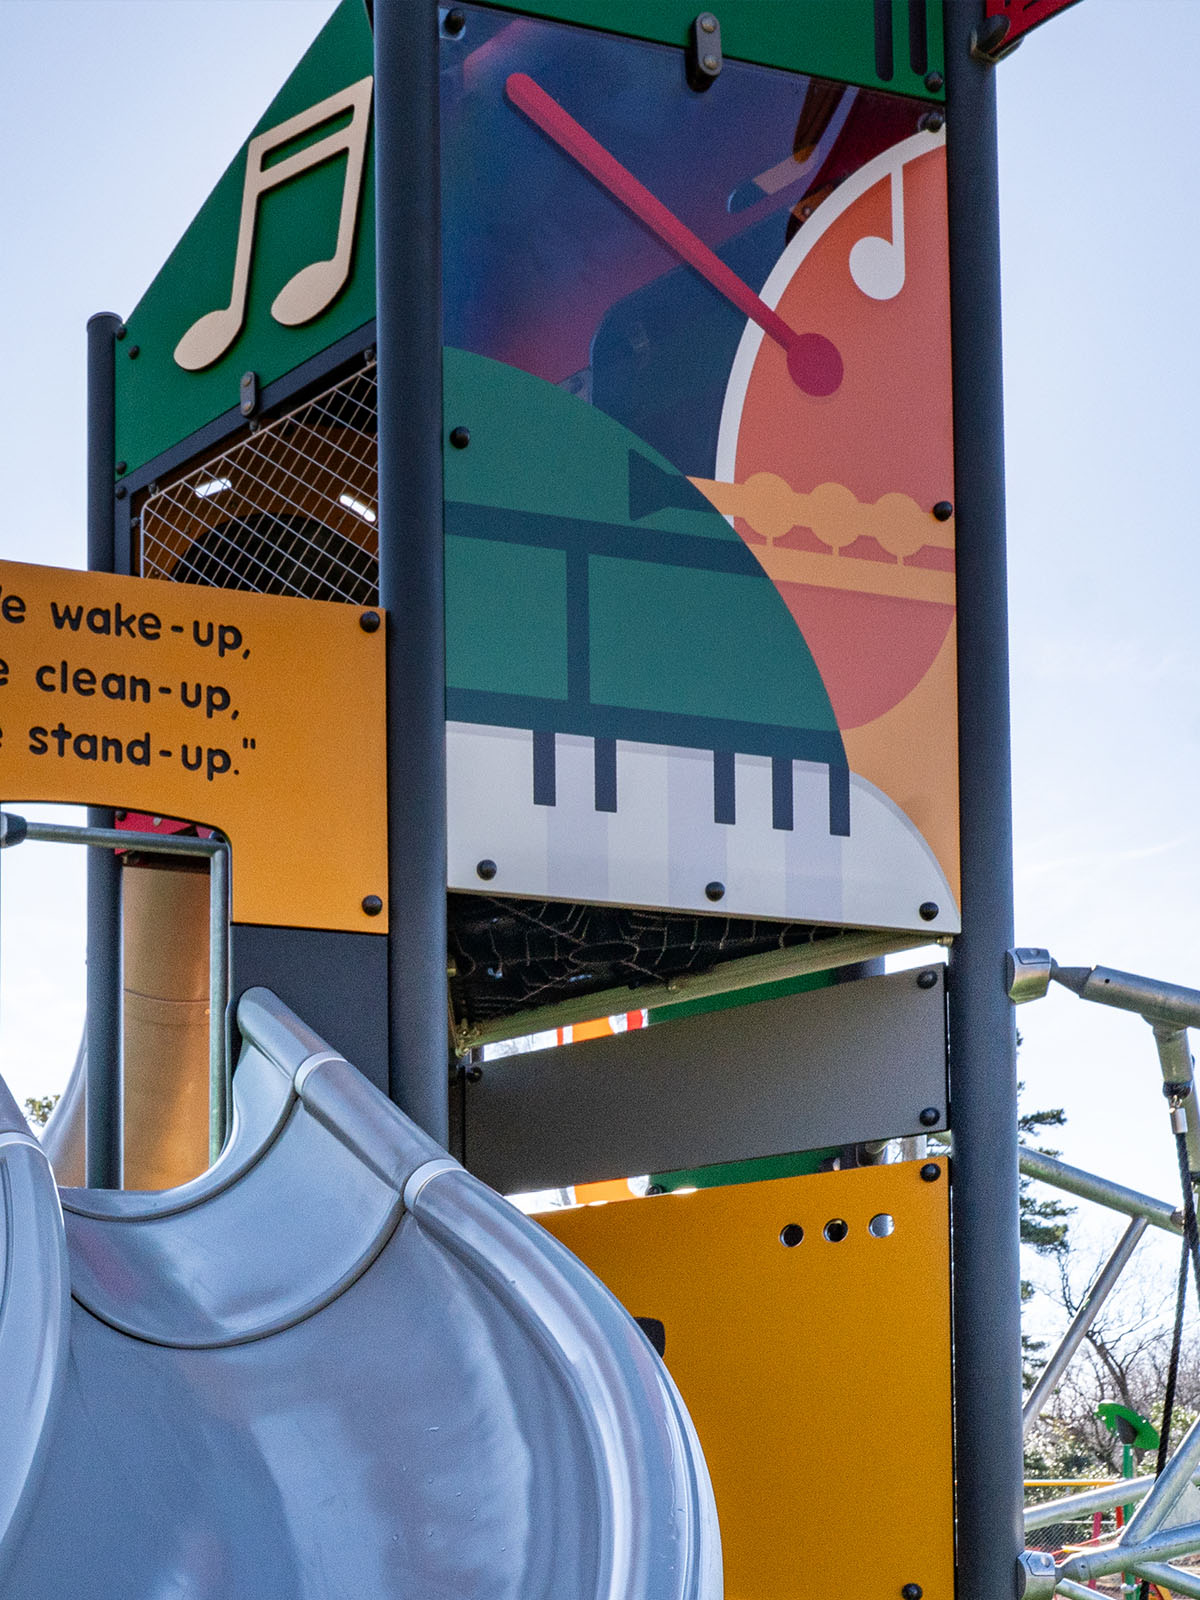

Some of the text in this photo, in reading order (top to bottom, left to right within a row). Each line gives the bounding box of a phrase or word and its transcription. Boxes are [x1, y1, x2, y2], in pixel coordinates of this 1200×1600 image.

[50, 602, 250, 660] wake-up,
[36, 660, 239, 720] clean-up,
[29, 722, 256, 781] stand-up."
